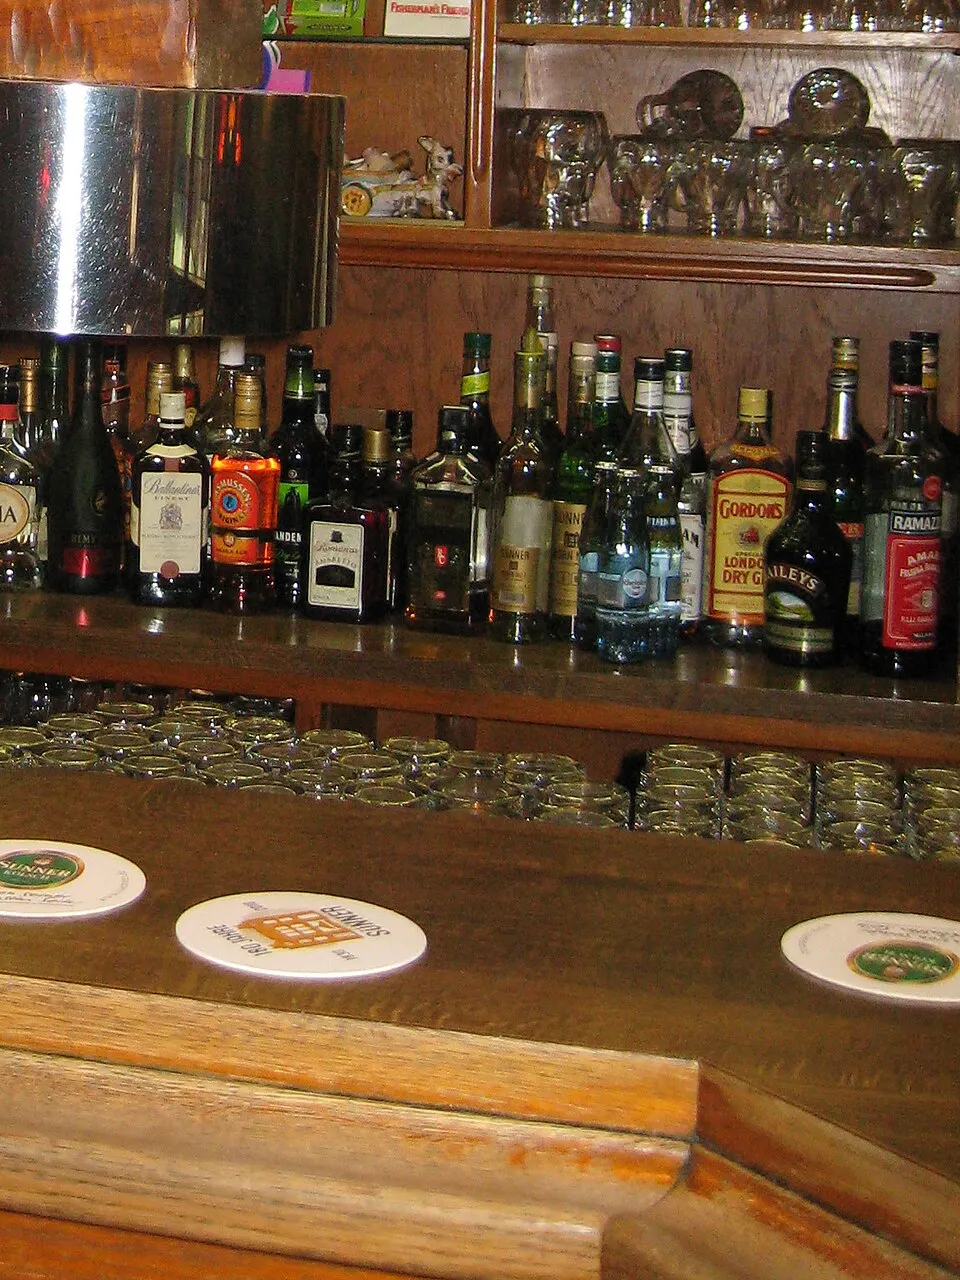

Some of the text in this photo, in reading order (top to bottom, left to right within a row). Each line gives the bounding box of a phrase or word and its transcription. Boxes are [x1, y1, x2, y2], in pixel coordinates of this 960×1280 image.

[719, 499, 783, 519] GORDON'S
[724, 556, 765, 570] LONDO
[722, 569, 750, 585] DRY
